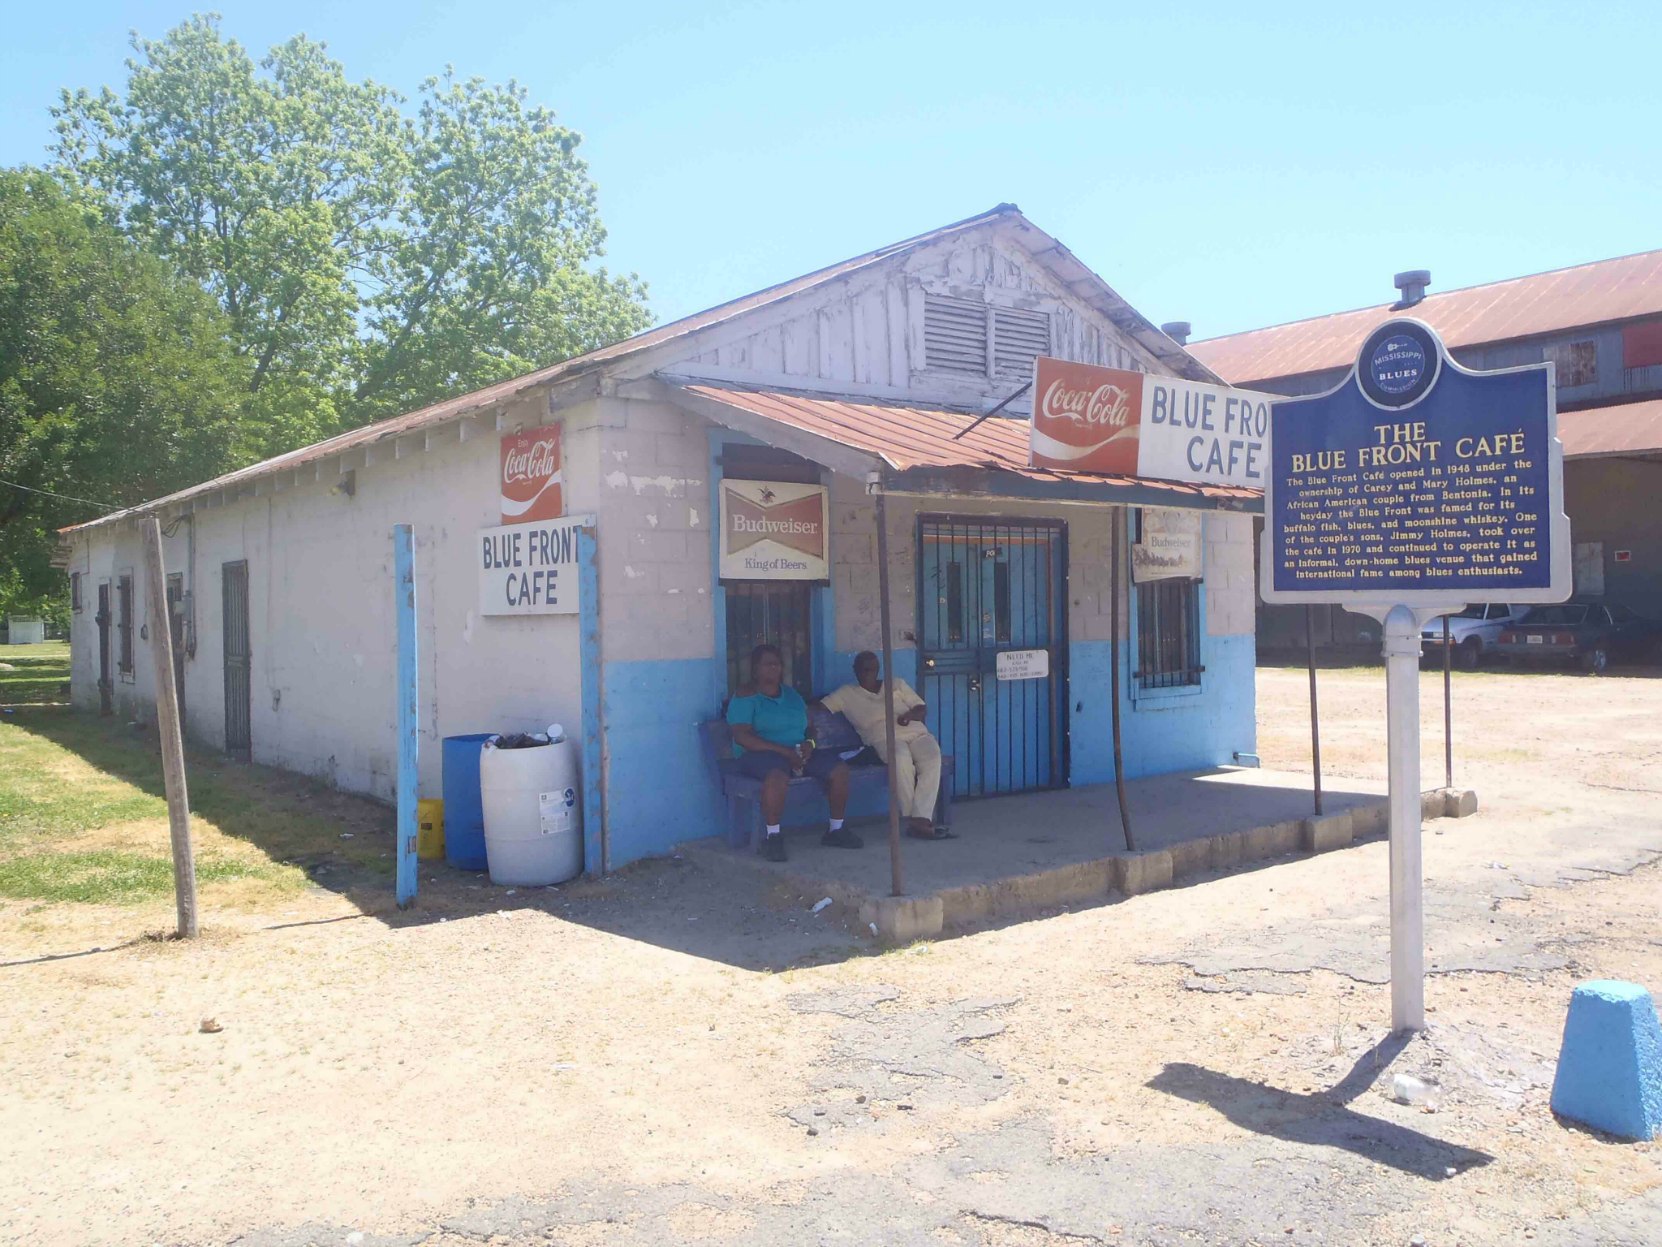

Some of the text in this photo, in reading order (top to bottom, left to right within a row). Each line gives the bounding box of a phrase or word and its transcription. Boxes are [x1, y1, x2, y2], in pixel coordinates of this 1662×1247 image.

[1375, 351, 1421, 365] MISSISSIPPI
[1380, 369, 1417, 380] BLUES
[1042, 379, 1129, 426] Coca-Cola
[1152, 386, 1267, 438] BLUE FRO
[1374, 422, 1425, 444] THE
[504, 438, 555, 483] Coca-Cola
[1187, 435, 1262, 479] CAFE
[1292, 428, 1525, 473] BLUE FRONT CAFÉ
[1287, 478, 1303, 486] The
[1308, 476, 1327, 485] Blue
[1332, 474, 1357, 483] Front
[1363, 470, 1384, 480] Café
[1390, 468, 1424, 479] opened
[1432, 467, 1442, 475] in
[1476, 462, 1507, 472] under
[1514, 459, 1532, 468] the
[1287, 501, 1319, 510] African
[1324, 497, 1367, 507] American
[1373, 494, 1404, 505] couple
[1410, 493, 1435, 501] from
[1519, 486, 1535, 495] its
[1299, 487, 1343, 497] ownership
[1348, 485, 1359, 493] of
[1364, 484, 1393, 493] Carey
[1398, 481, 1416, 490] and
[1423, 479, 1448, 489] Mary
[1301, 500, 1516, 521] heyday the Blue Front was famed for its
[732, 514, 818, 534] Budweiser
[1284, 523, 1316, 533] buffalo
[1381, 519, 1398, 528] and
[1405, 516, 1458, 527] moonshine
[1515, 512, 1538, 522] One
[1285, 536, 1296, 544] of
[1301, 534, 1315, 543] the
[1319, 532, 1354, 544] couple's
[1390, 530, 1424, 540] Jimmy
[1479, 526, 1504, 536] took
[1511, 526, 1536, 535] over
[483, 525, 580, 569] BLUE FRONT
[1285, 547, 1300, 556] the
[1328, 547, 1337, 555] in
[1342, 545, 1361, 554] 1970
[1366, 544, 1383, 553] and
[1389, 542, 1437, 552] continued
[1443, 542, 1454, 550] to
[1459, 540, 1501, 552] operate
[1507, 539, 1517, 548] it
[1523, 540, 1536, 548] as
[745, 557, 808, 571] King of Beers
[1284, 560, 1295, 568] an
[1405, 555, 1430, 564] blues
[1436, 555, 1465, 563] venue
[1471, 553, 1495, 562] that
[1500, 551, 1537, 563] gained
[1296, 565, 1523, 579] international fame among blues enthusiasts.
[506, 570, 558, 606] CAFE
